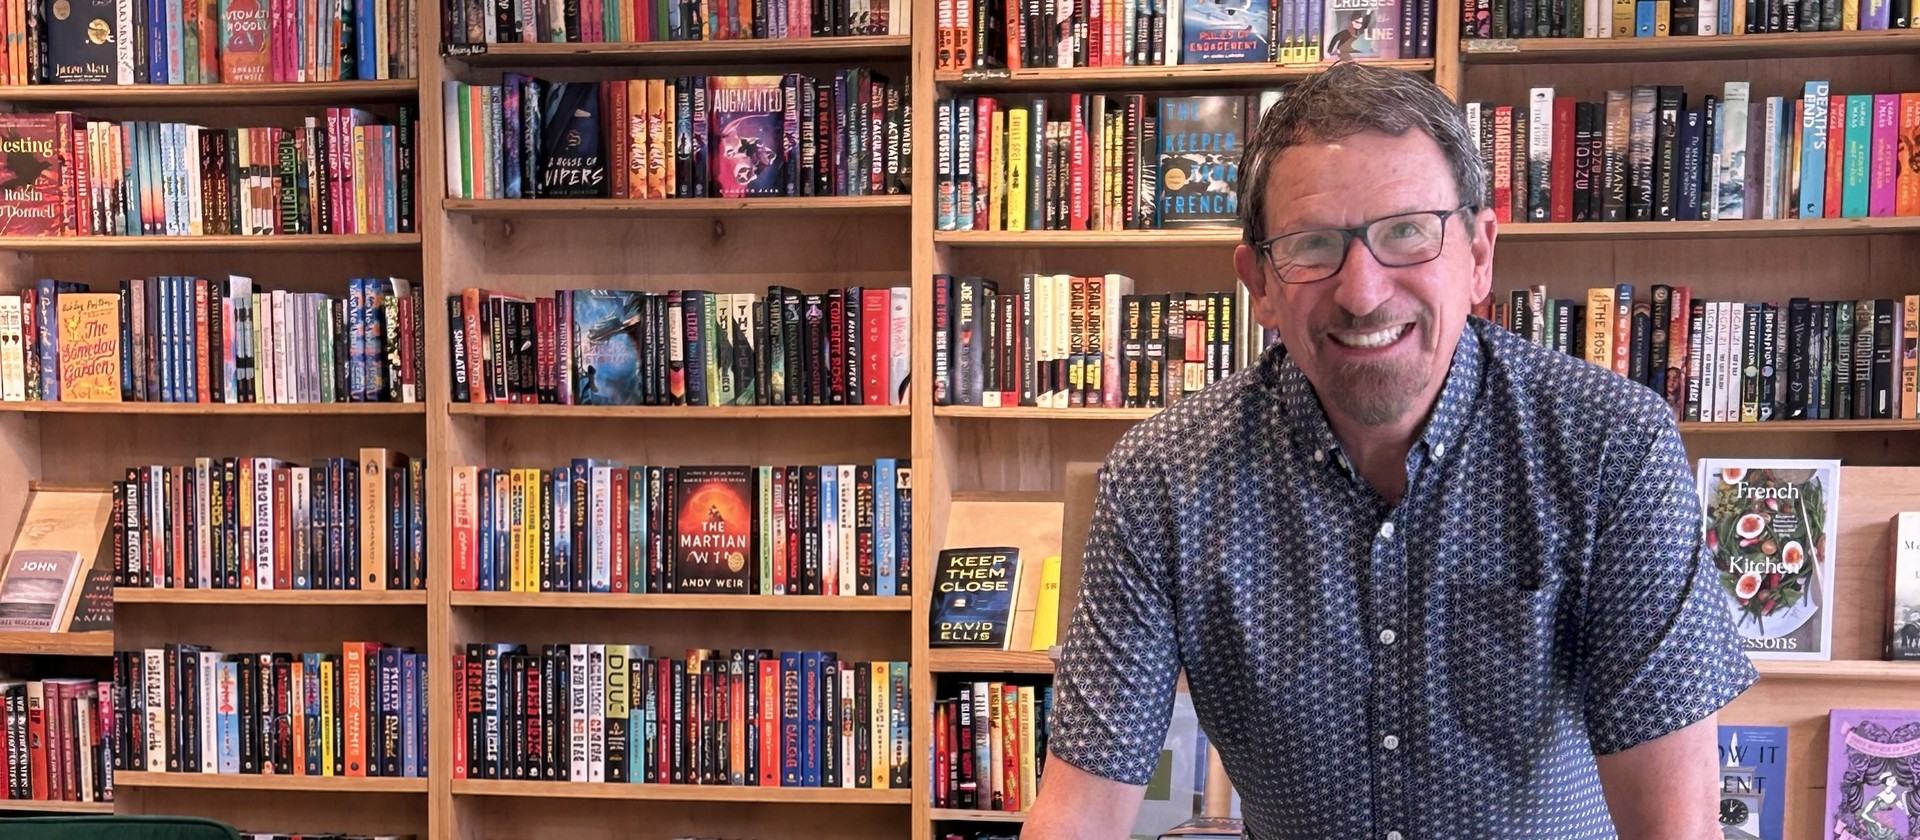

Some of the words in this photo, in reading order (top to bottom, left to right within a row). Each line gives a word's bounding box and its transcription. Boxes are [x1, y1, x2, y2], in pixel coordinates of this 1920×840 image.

[1364, 28, 1394, 41] LINE
[714, 88, 782, 113] AUGMENTED
[959, 106, 970, 133] CLIVE
[1166, 102, 1201, 120] THE
[1803, 94, 1815, 128] END
[1813, 84, 1829, 149] DEATH'S
[0, 137, 54, 158] esting
[872, 119, 882, 174] CALCULATED
[888, 121, 899, 174] ACTIVATED
[1165, 132, 1236, 153] KEEPER
[544, 167, 605, 186] VIPERS
[1613, 161, 1624, 202] MANY
[1164, 195, 1238, 214] FRENCH
[961, 282, 973, 302] JOE
[1070, 282, 1084, 310] CRAIG
[1088, 281, 1101, 310] CRAIG
[961, 303, 973, 325] HILL
[1169, 300, 1178, 336] KING
[1595, 304, 1606, 328] THE
[1693, 317, 1702, 331] THE
[83, 321, 108, 338] The
[62, 339, 116, 362] Someday
[1594, 331, 1606, 362] ROSE
[1618, 305, 1628, 376] DETOU
[454, 330, 466, 383] SIMULATED
[63, 358, 115, 390] Garden
[831, 357, 843, 391] ROSE
[1688, 379, 1699, 402] PEACE
[1736, 481, 1799, 500] French
[701, 522, 725, 532] THE
[680, 534, 746, 548] MARTIAN
[21, 561, 57, 572] JOHN
[950, 555, 1007, 567] KEEP
[1729, 556, 1800, 575] Kitchen
[682, 579, 711, 588] ANDY
[716, 579, 744, 588] WEIR
[946, 568, 1006, 579] THEM
[940, 581, 1008, 592] CLOSE
[940, 631, 990, 641] ELLIS
[941, 622, 993, 631] DAVID
[1741, 636, 1798, 650] essons
[961, 690, 971, 701] THE
[961, 703, 971, 726] ISLAND
[1759, 745, 1781, 763] IT
[1723, 777, 1767, 794] ENT
